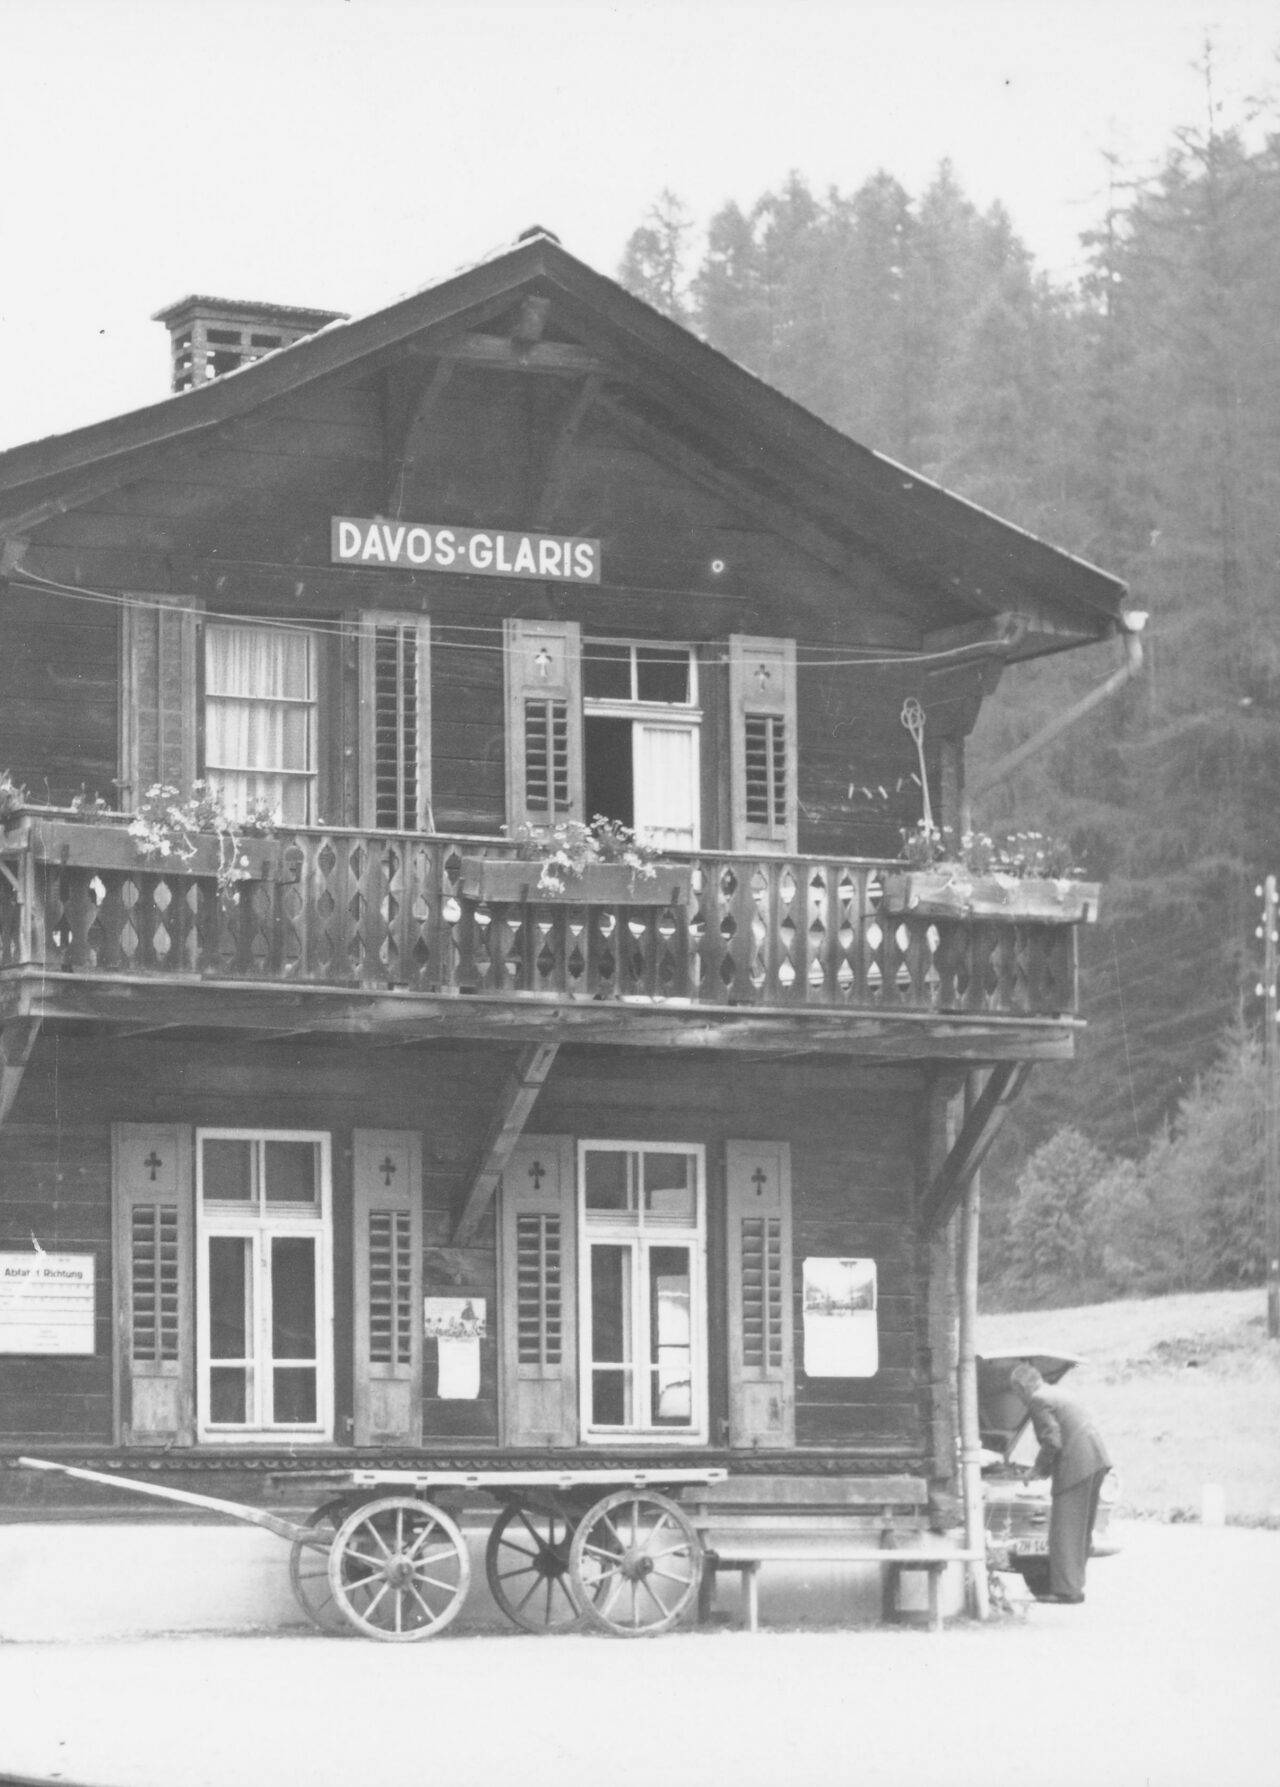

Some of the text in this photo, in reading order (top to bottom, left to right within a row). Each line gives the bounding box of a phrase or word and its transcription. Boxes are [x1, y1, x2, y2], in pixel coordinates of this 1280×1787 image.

[339, 522, 594, 578] DAVOS-GLARIS
[4, 1268, 83, 1279] Abfat Richtung
